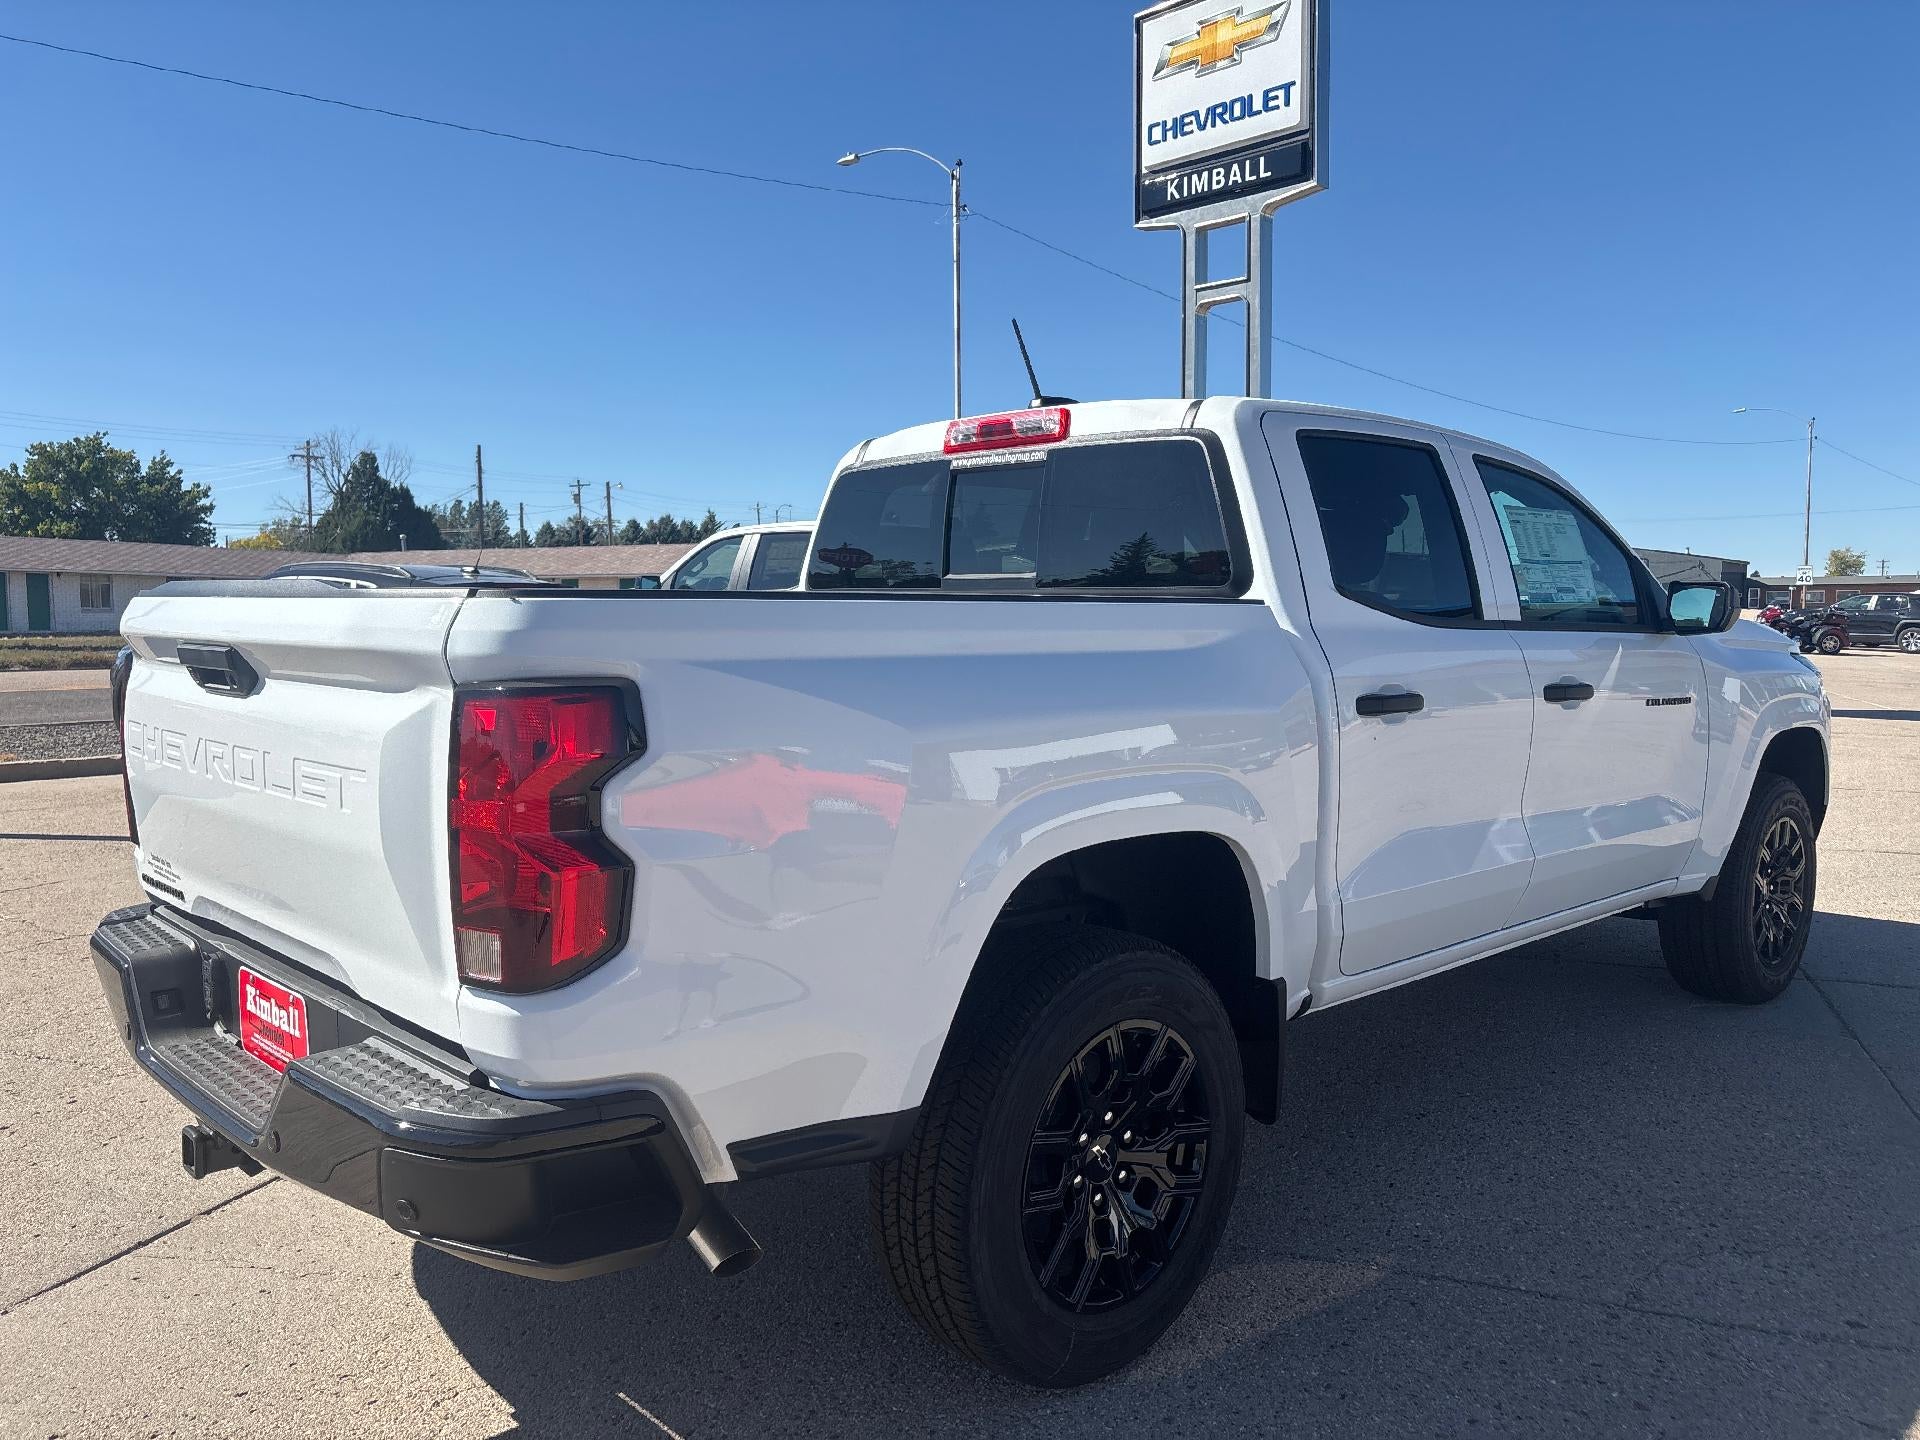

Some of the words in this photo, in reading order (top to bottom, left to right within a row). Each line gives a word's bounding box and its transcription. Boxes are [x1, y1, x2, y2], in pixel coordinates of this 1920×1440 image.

[1147, 80, 1296, 146] CHEVROLET
[1167, 156, 1272, 201] KIMBALL
[1798, 575, 1811, 583] 40
[128, 720, 367, 814] CHEVROLET
[246, 983, 300, 1039] Kimball
